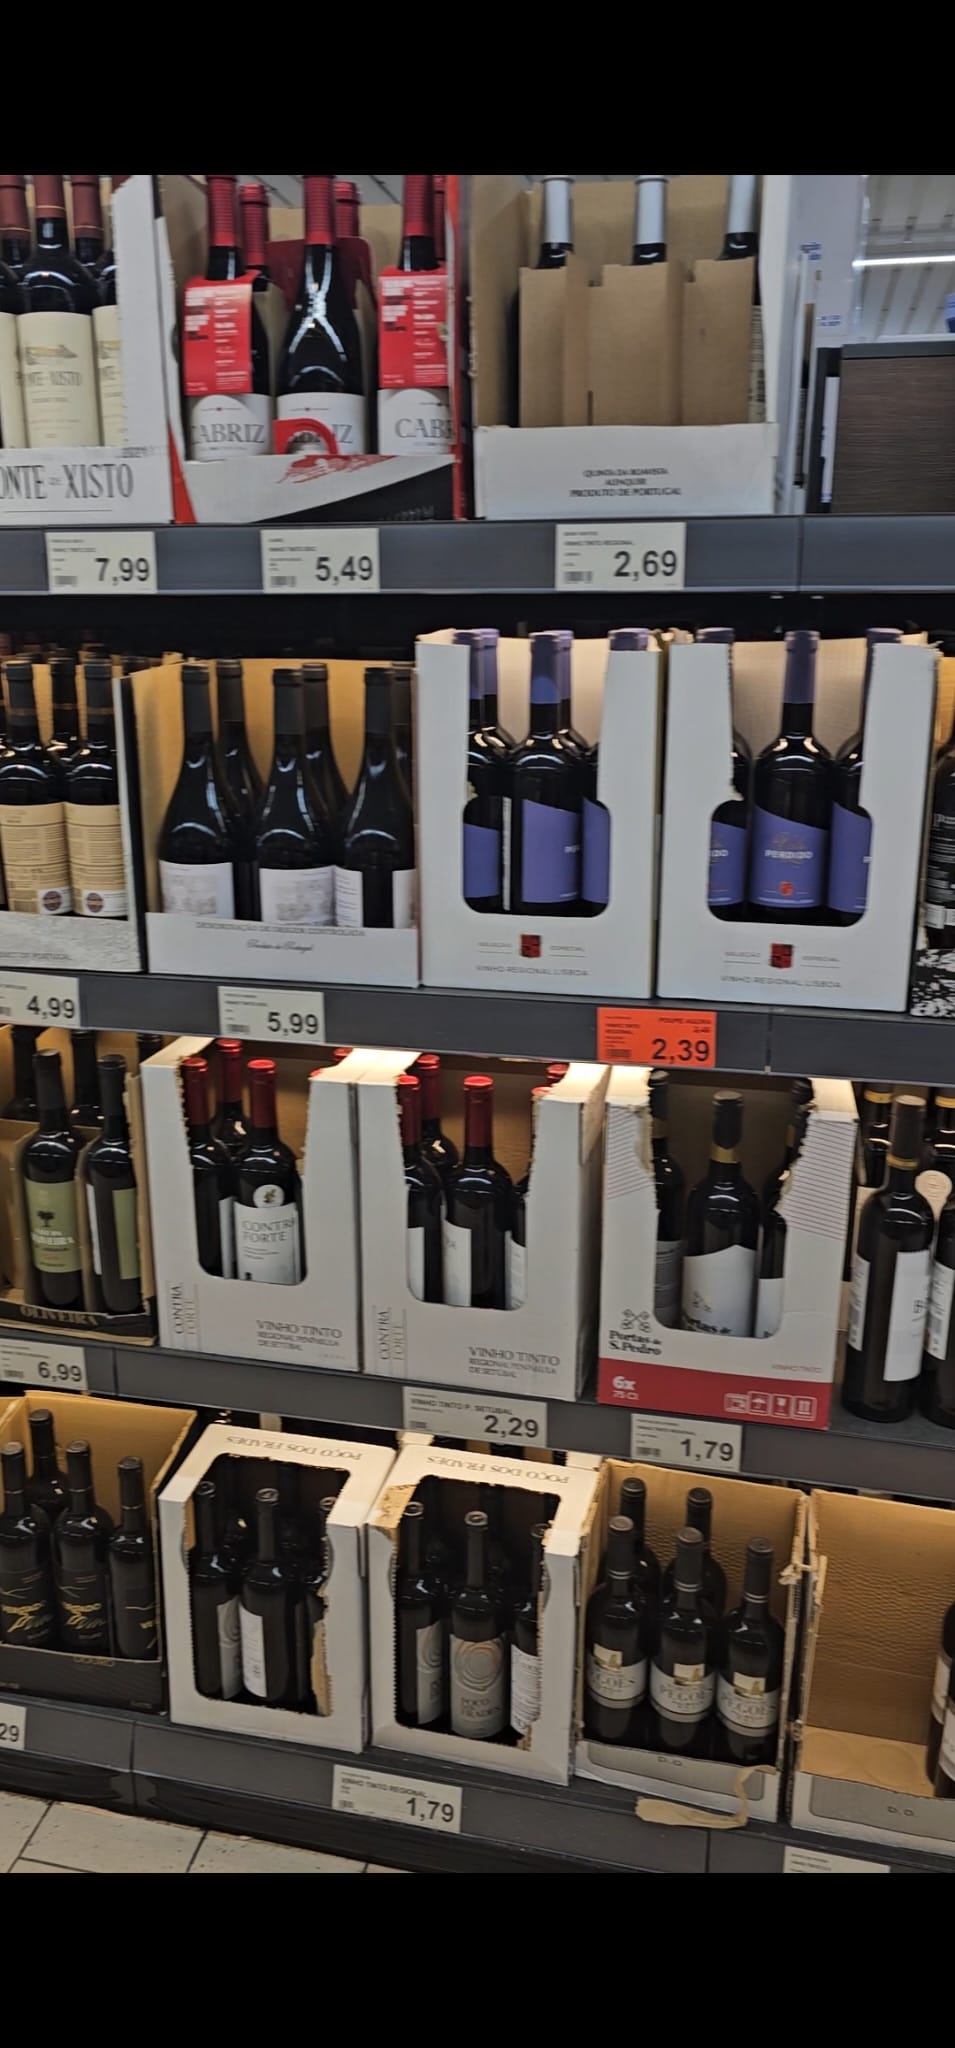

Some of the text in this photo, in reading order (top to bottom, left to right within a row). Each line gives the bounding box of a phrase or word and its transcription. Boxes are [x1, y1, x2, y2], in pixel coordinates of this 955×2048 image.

[62, 462, 135, 499] XISTO
[569, 488, 615, 498] PRODUTO
[632, 486, 682, 497] PORTUGAL
[94, 557, 151, 587] 7,99
[315, 555, 374, 586] 5,49
[613, 549, 678, 582] 2,69
[720, 976, 749, 984] VINHO
[27, 995, 76, 1020] 4,99
[267, 1011, 319, 1037] 5,99
[652, 1038, 710, 1064] 2,39
[242, 1231, 288, 1243] FORTE
[171, 1285, 184, 1335] CONTRA
[256, 1320, 343, 1339] VINHO TINTO
[377, 1310, 391, 1361] CONTRA
[608, 1329, 650, 1345] Portas
[468, 1346, 561, 1367] VINHO TINTO
[38, 1361, 83, 1383] 6,99
[612, 1375, 637, 1391] 6x
[410, 1398, 437, 1408] VINHO
[438, 1400, 463, 1410] TINTO
[484, 1414, 539, 1439] 2,29
[223, 1434, 362, 1461] POÇO DOS FRADES
[680, 1438, 735, 1462] 1,79
[426, 1455, 569, 1485] POÇO DOS FRADES
[341, 1778, 364, 1787] VINHO
[365, 1781, 389, 1791] TINTO
[406, 1797, 455, 1823] 1,79
